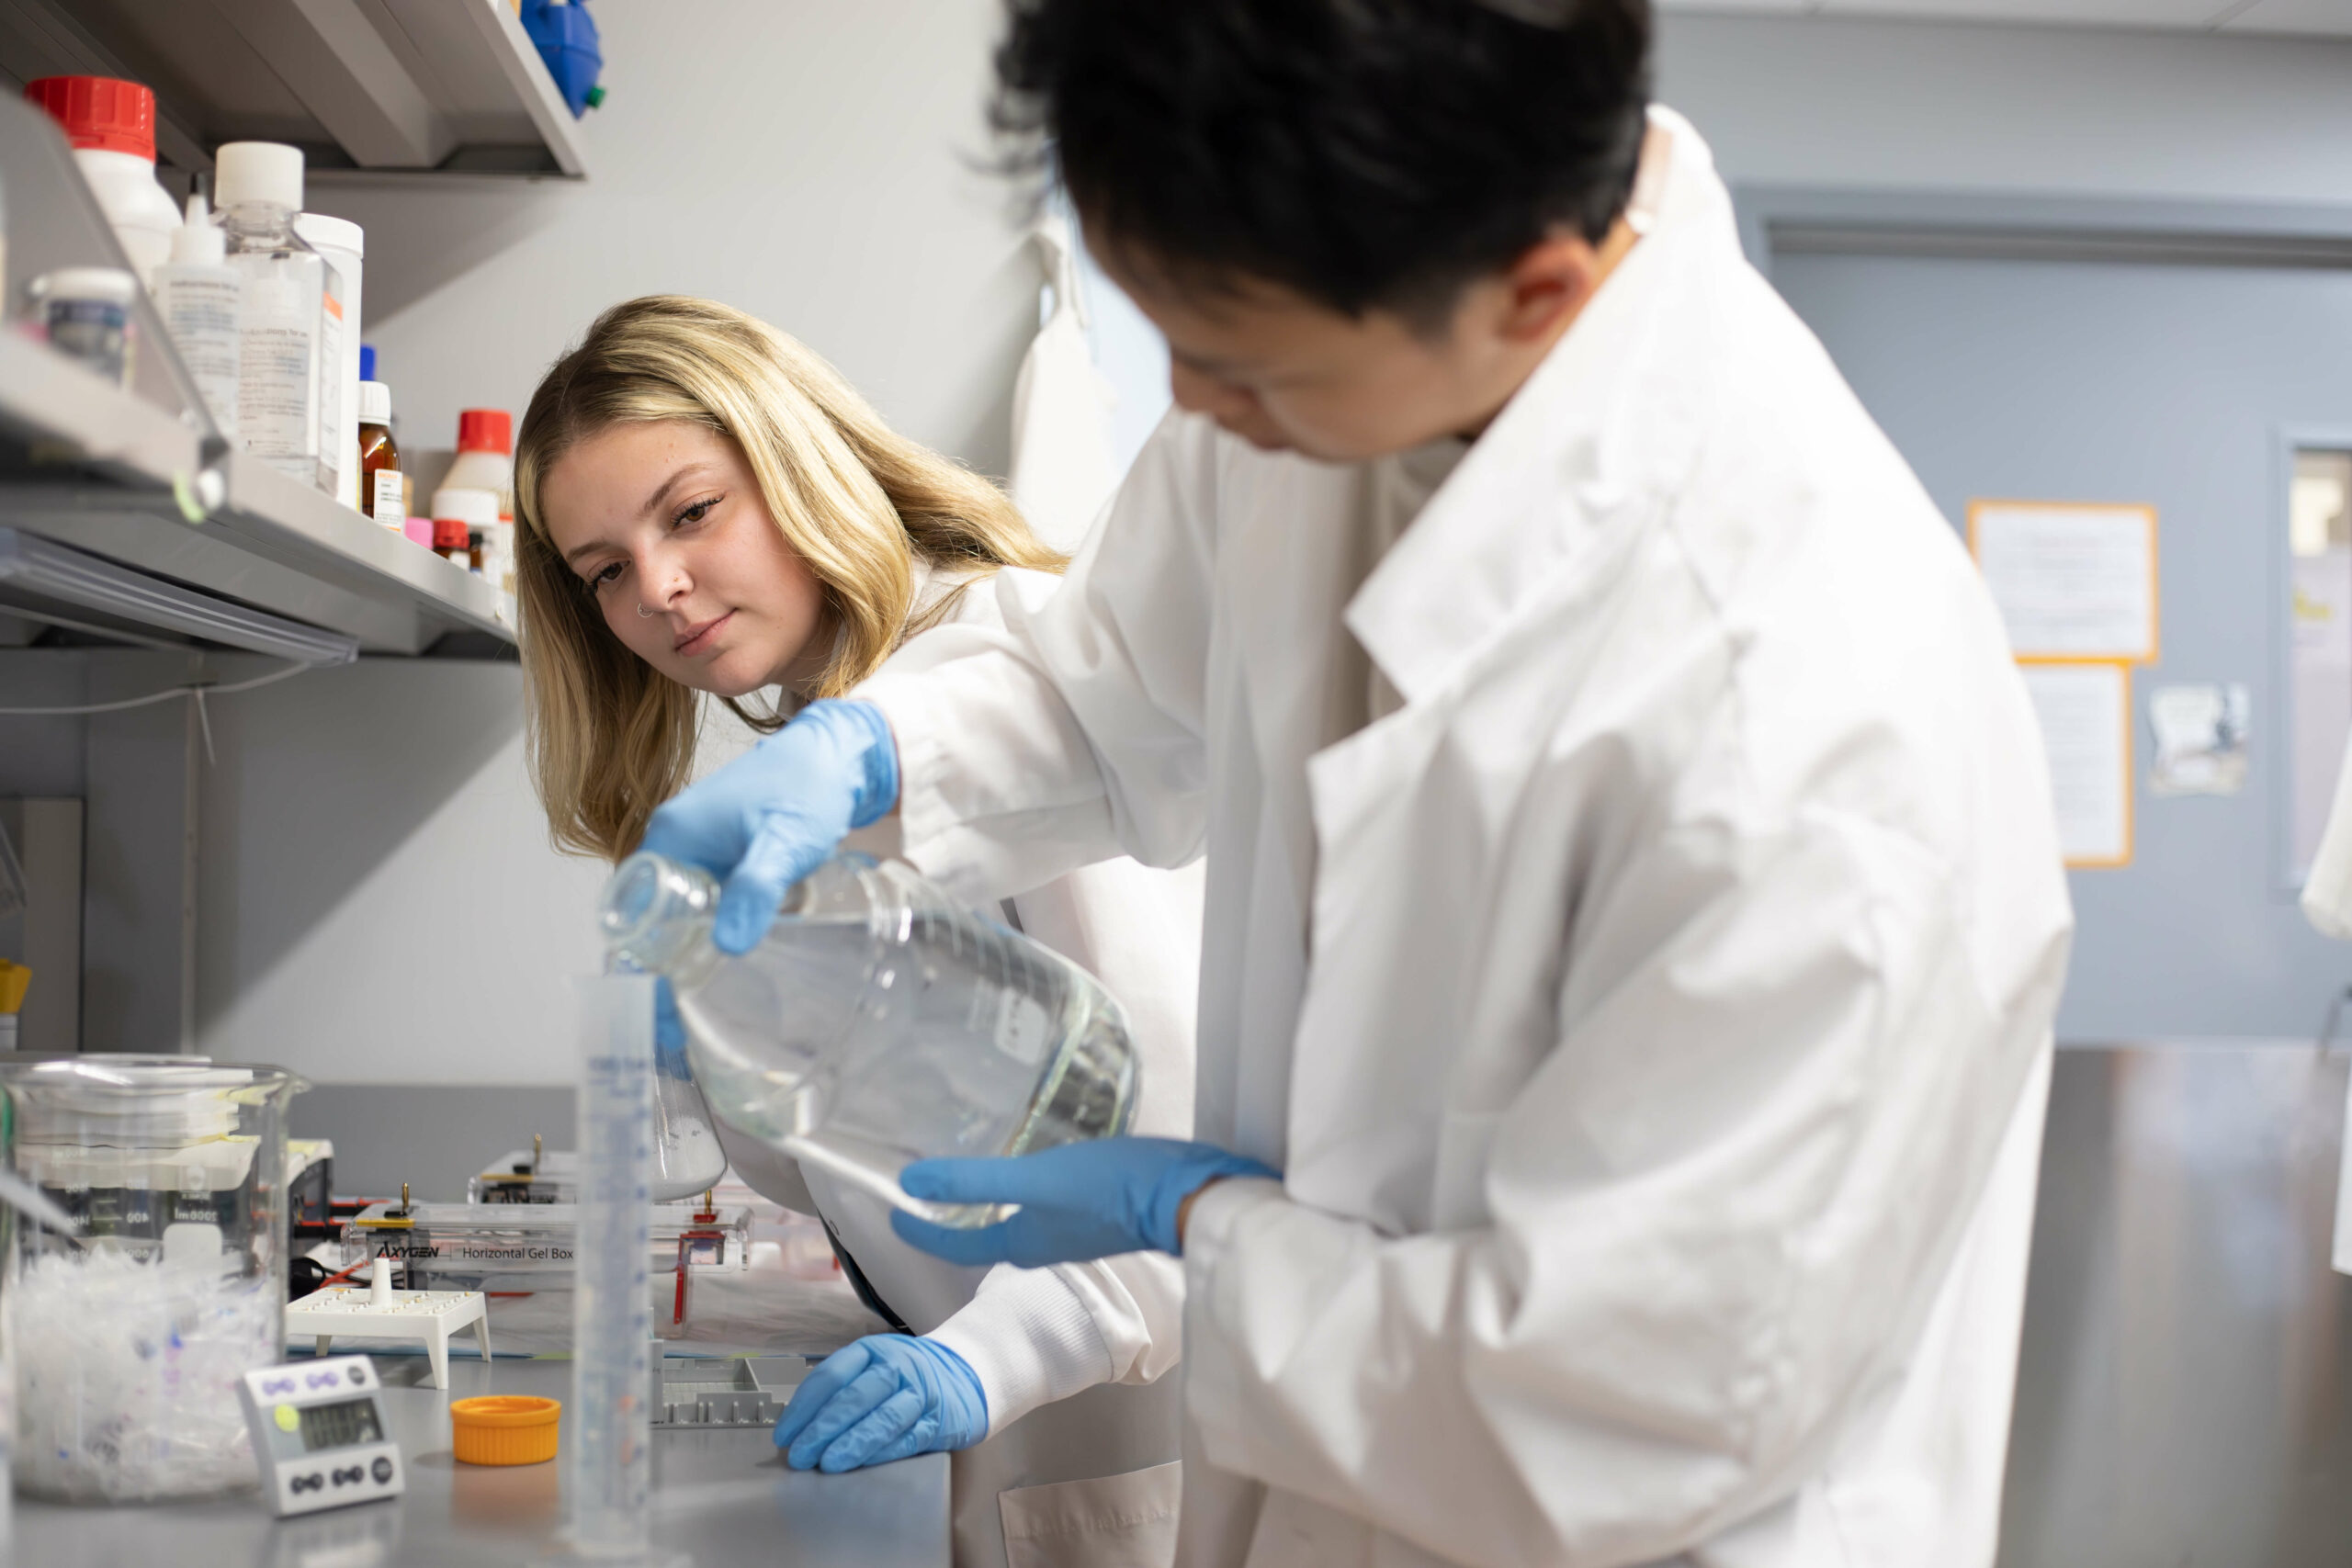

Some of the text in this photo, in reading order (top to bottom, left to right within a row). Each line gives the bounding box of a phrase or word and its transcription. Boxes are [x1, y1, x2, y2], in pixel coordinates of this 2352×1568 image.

[462, 1247, 574, 1260] Horizontal Gel Box
